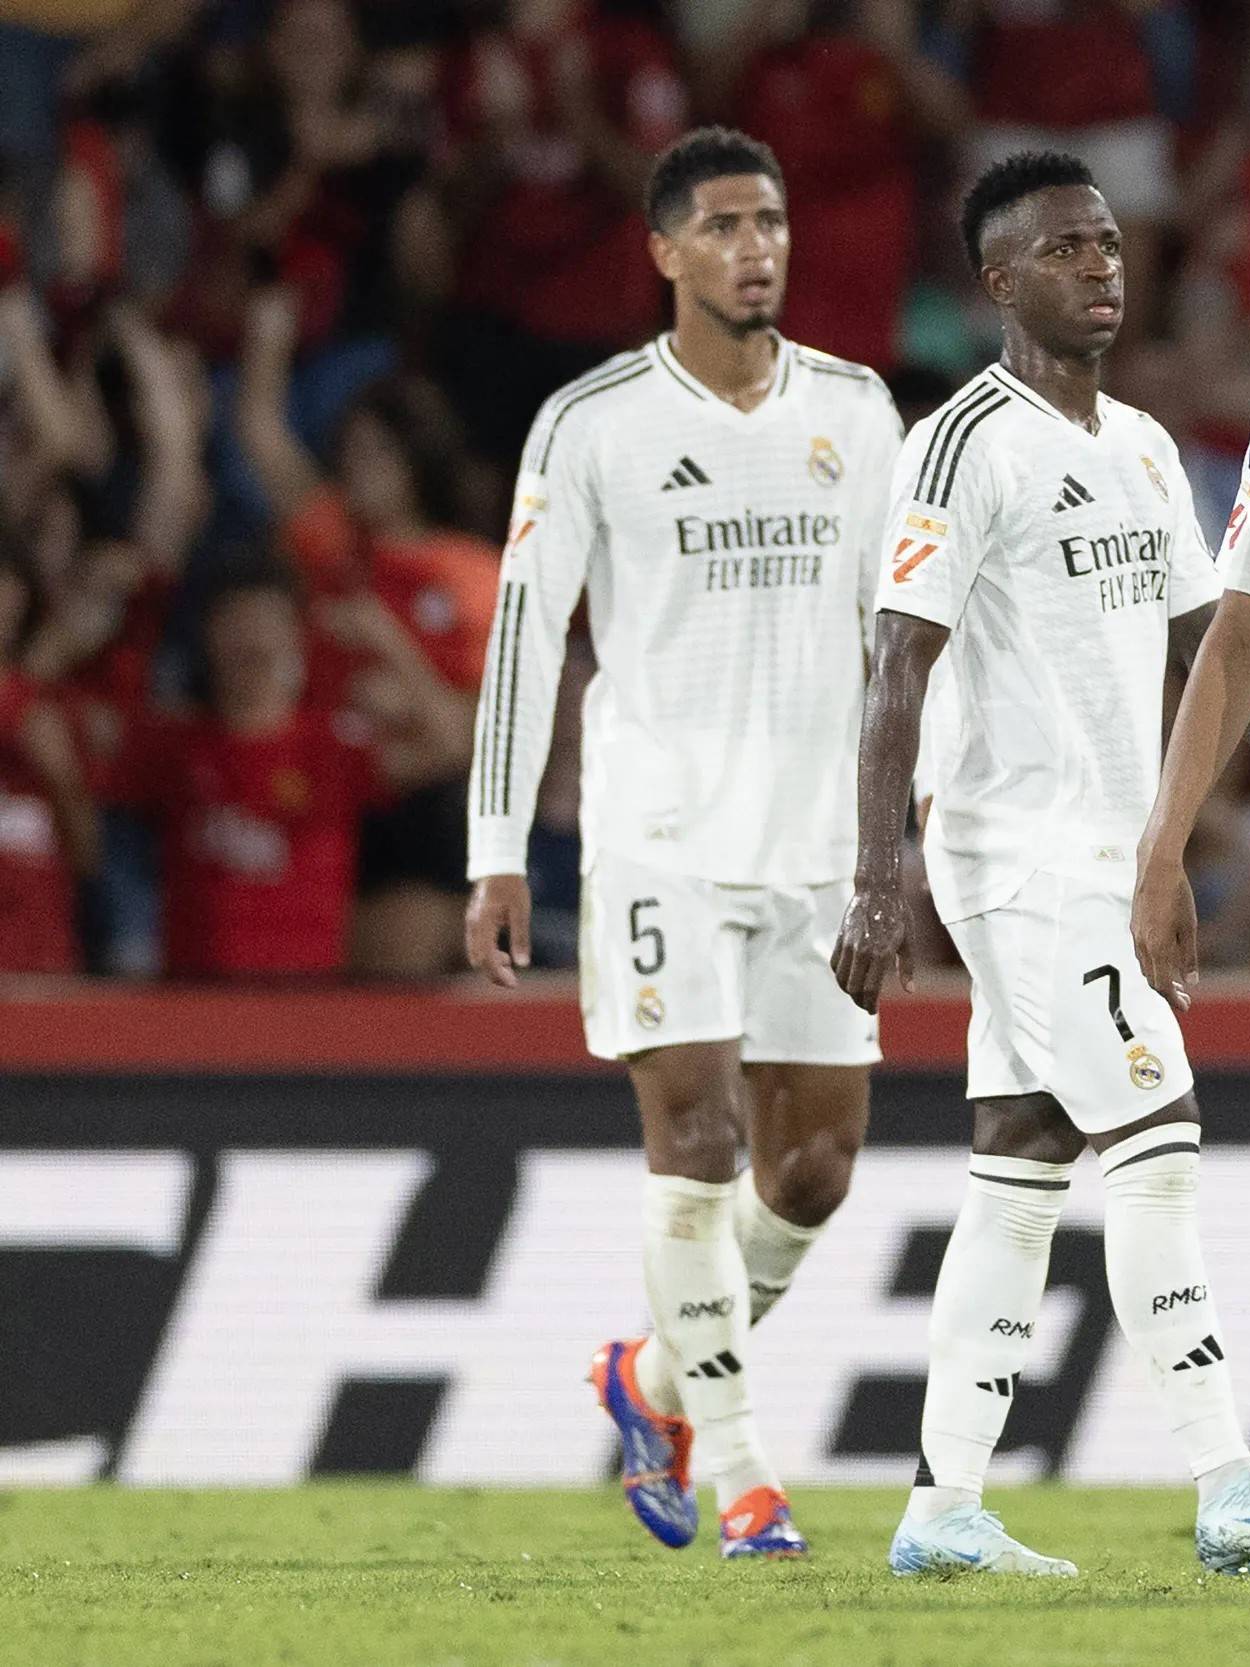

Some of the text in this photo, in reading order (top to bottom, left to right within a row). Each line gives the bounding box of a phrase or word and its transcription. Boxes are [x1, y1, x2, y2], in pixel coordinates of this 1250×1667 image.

[675, 505, 841, 555] Emirates
[1058, 522, 1171, 577] Emirate
[706, 554, 823, 591] FLY BETTER
[1100, 574, 1125, 613] FLY
[630, 897, 665, 976] 5
[1083, 964, 1135, 1042] 7
